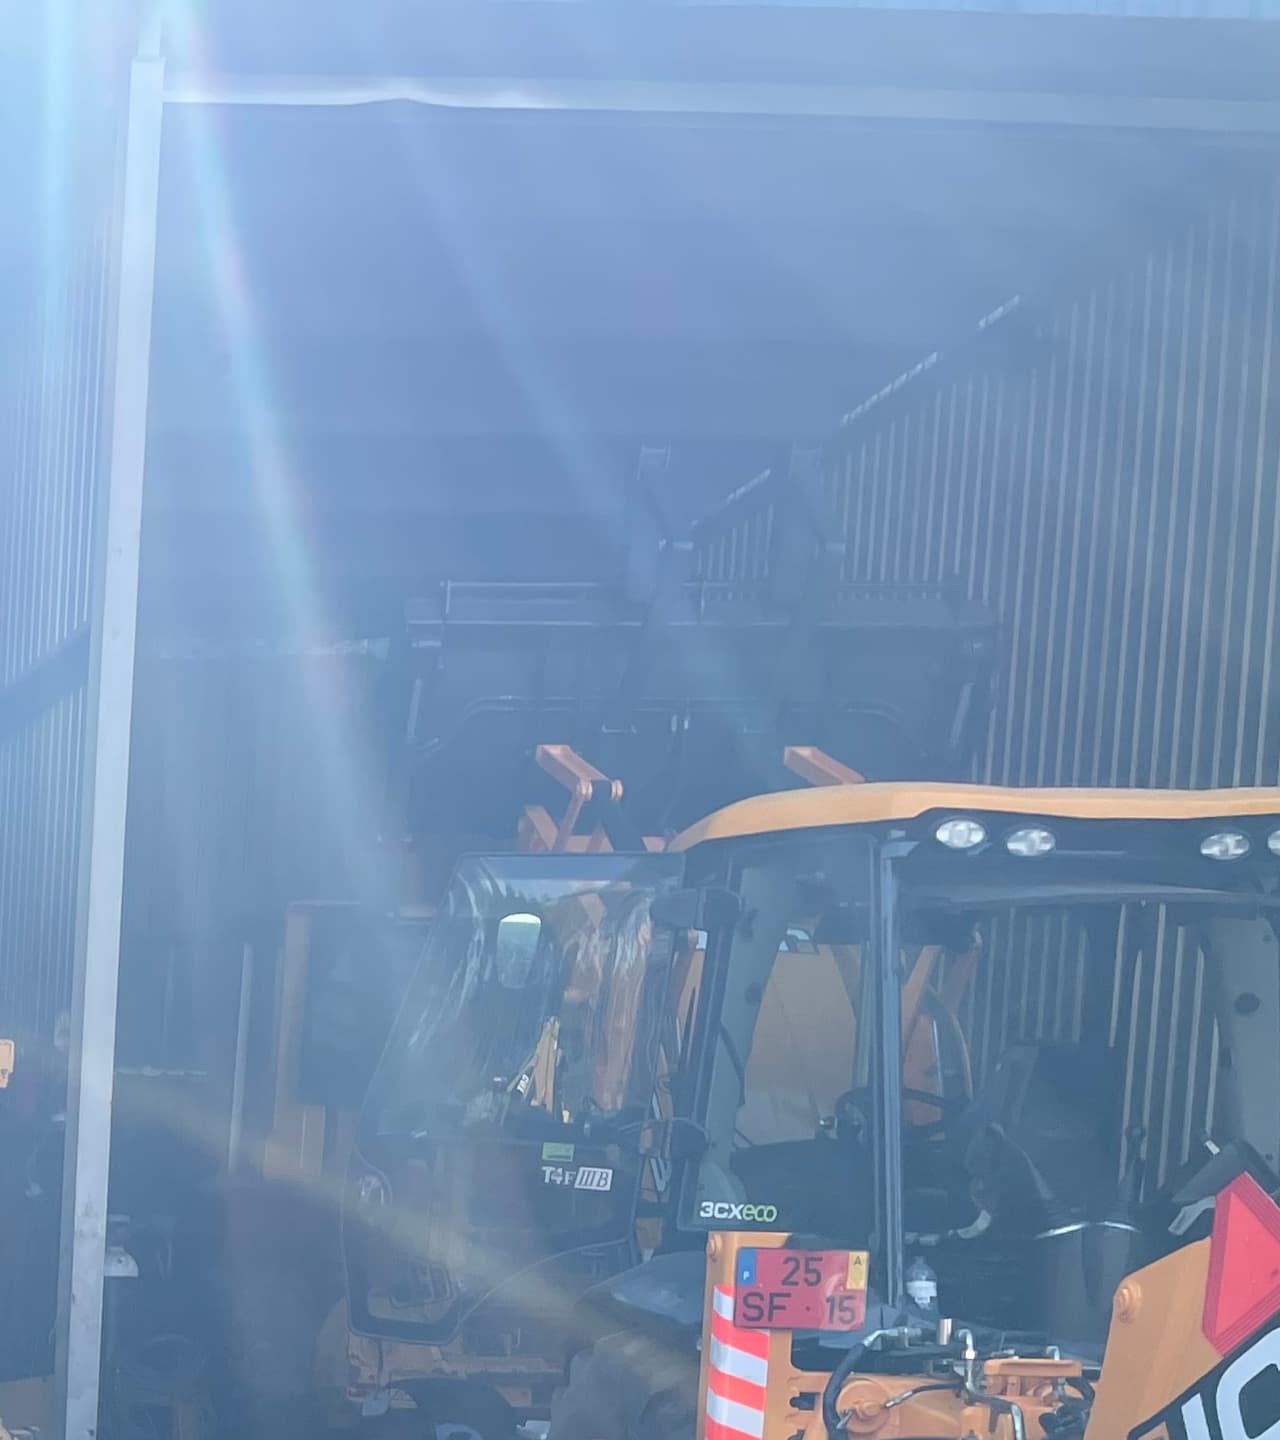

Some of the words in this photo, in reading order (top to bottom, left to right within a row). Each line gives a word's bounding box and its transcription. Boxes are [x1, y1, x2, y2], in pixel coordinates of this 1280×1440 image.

[700, 1201, 777, 1222] 3CXeco
[781, 1256, 823, 1287] 25
[742, 1292, 792, 1322] SF
[826, 1295, 856, 1324] 15
